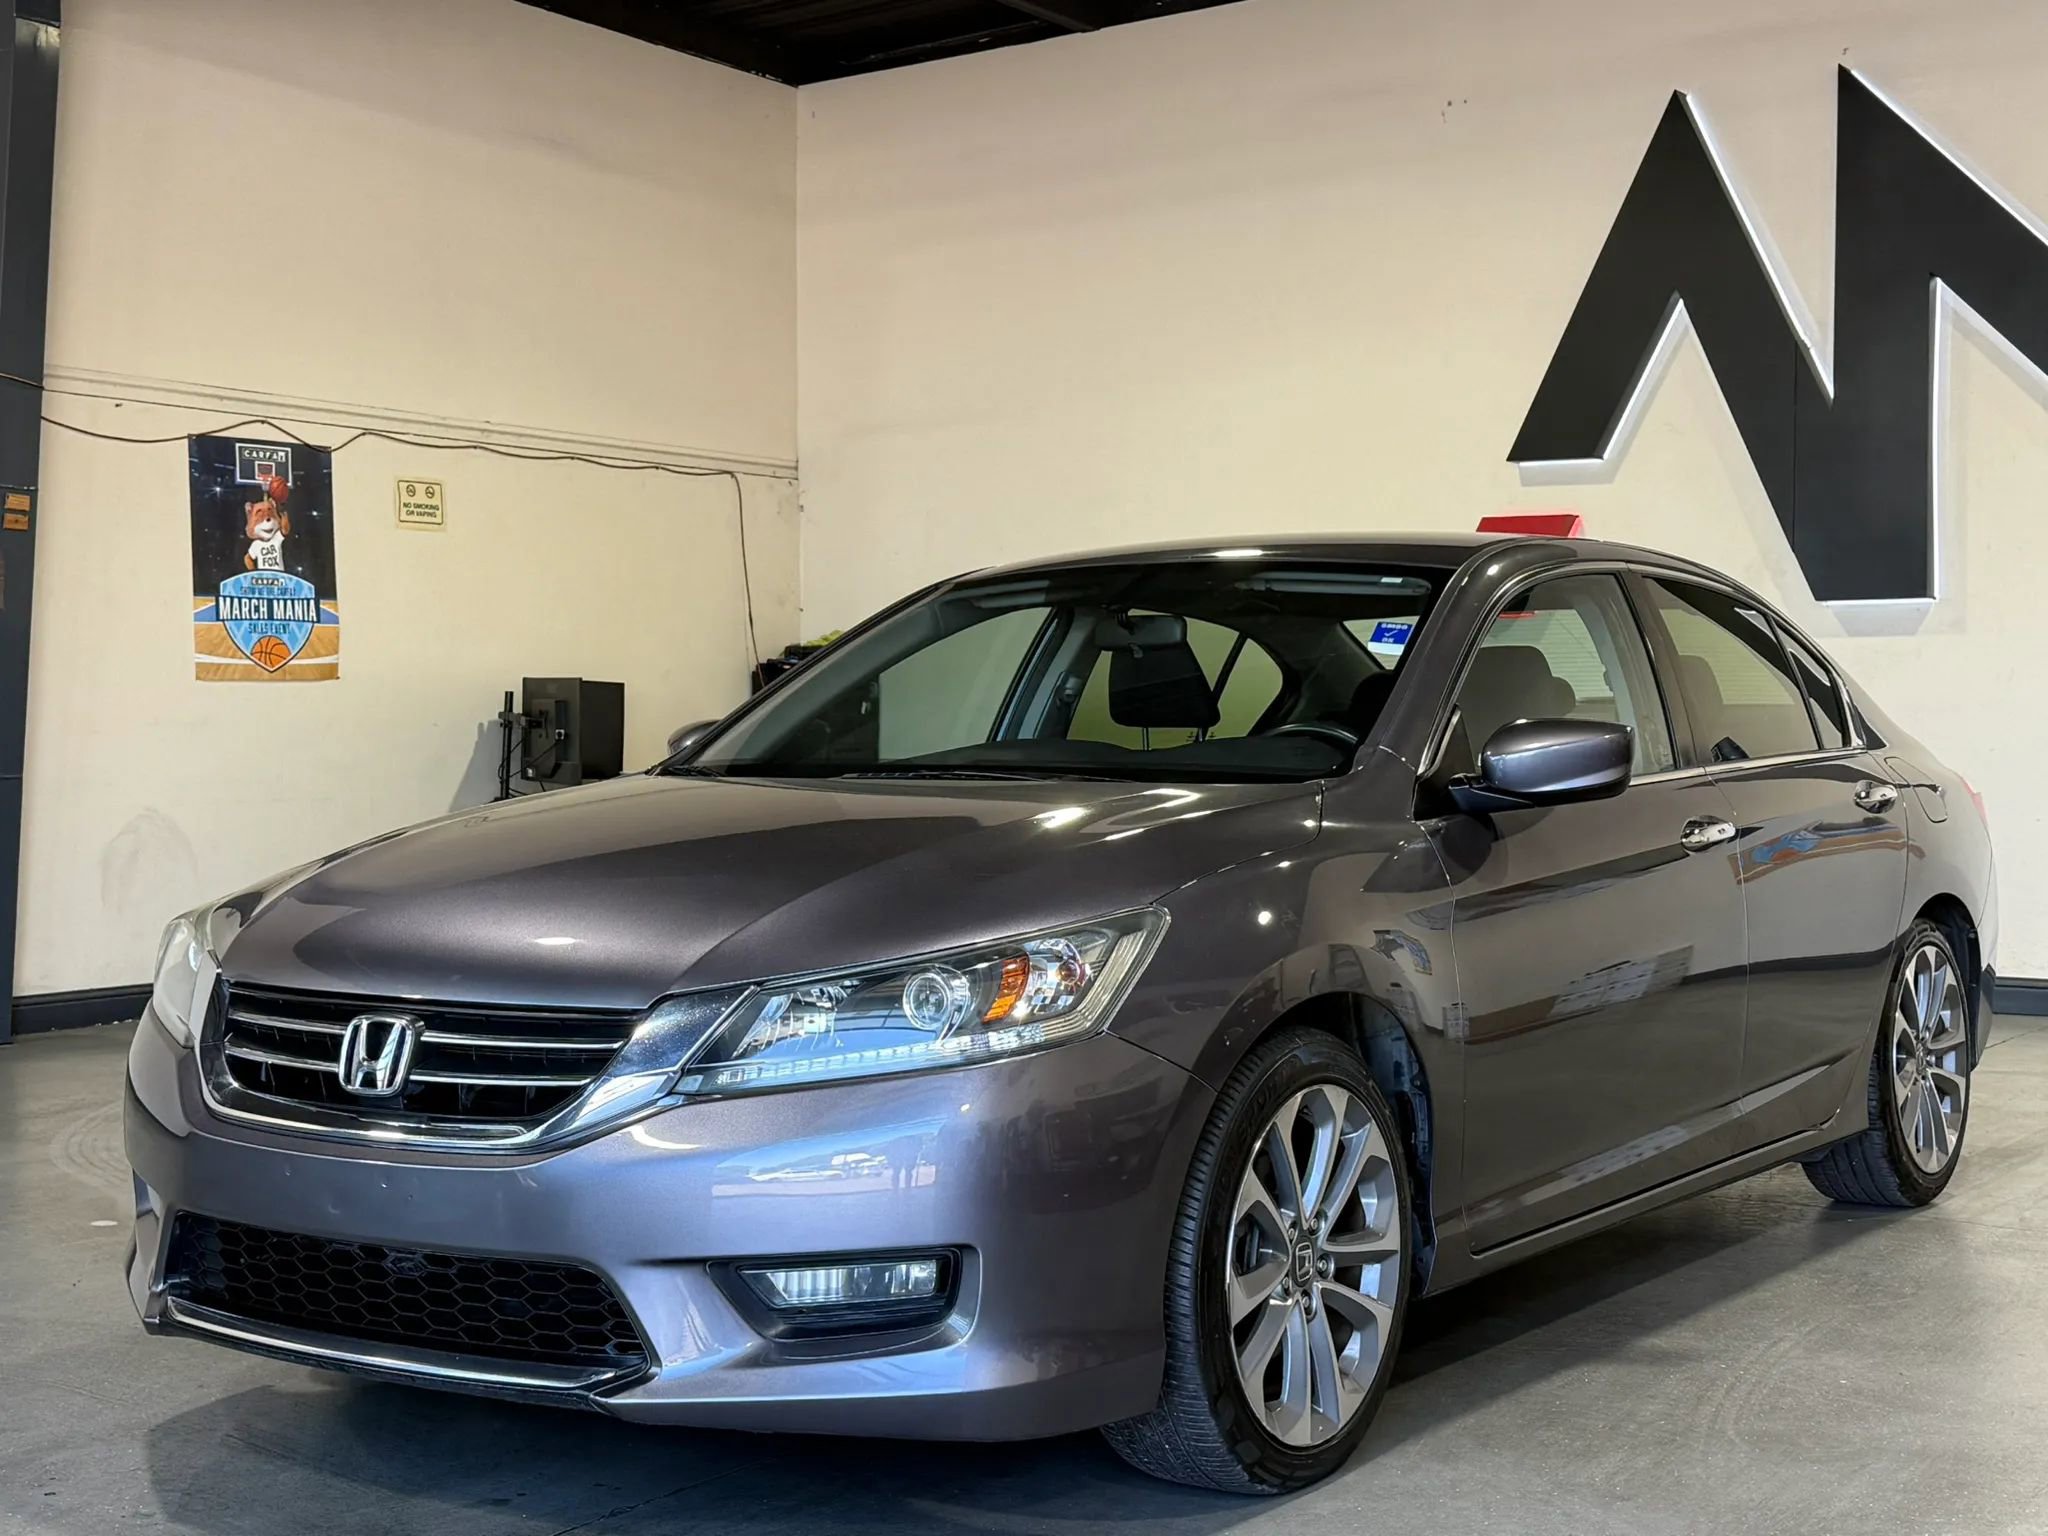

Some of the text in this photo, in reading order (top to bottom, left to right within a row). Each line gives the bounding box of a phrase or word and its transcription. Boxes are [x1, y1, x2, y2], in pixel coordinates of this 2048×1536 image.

[413, 503, 440, 511] SMOKING
[260, 544, 277, 556] CAR
[262, 556, 280, 567] FOX
[219, 597, 317, 621] MARCH MANIA
